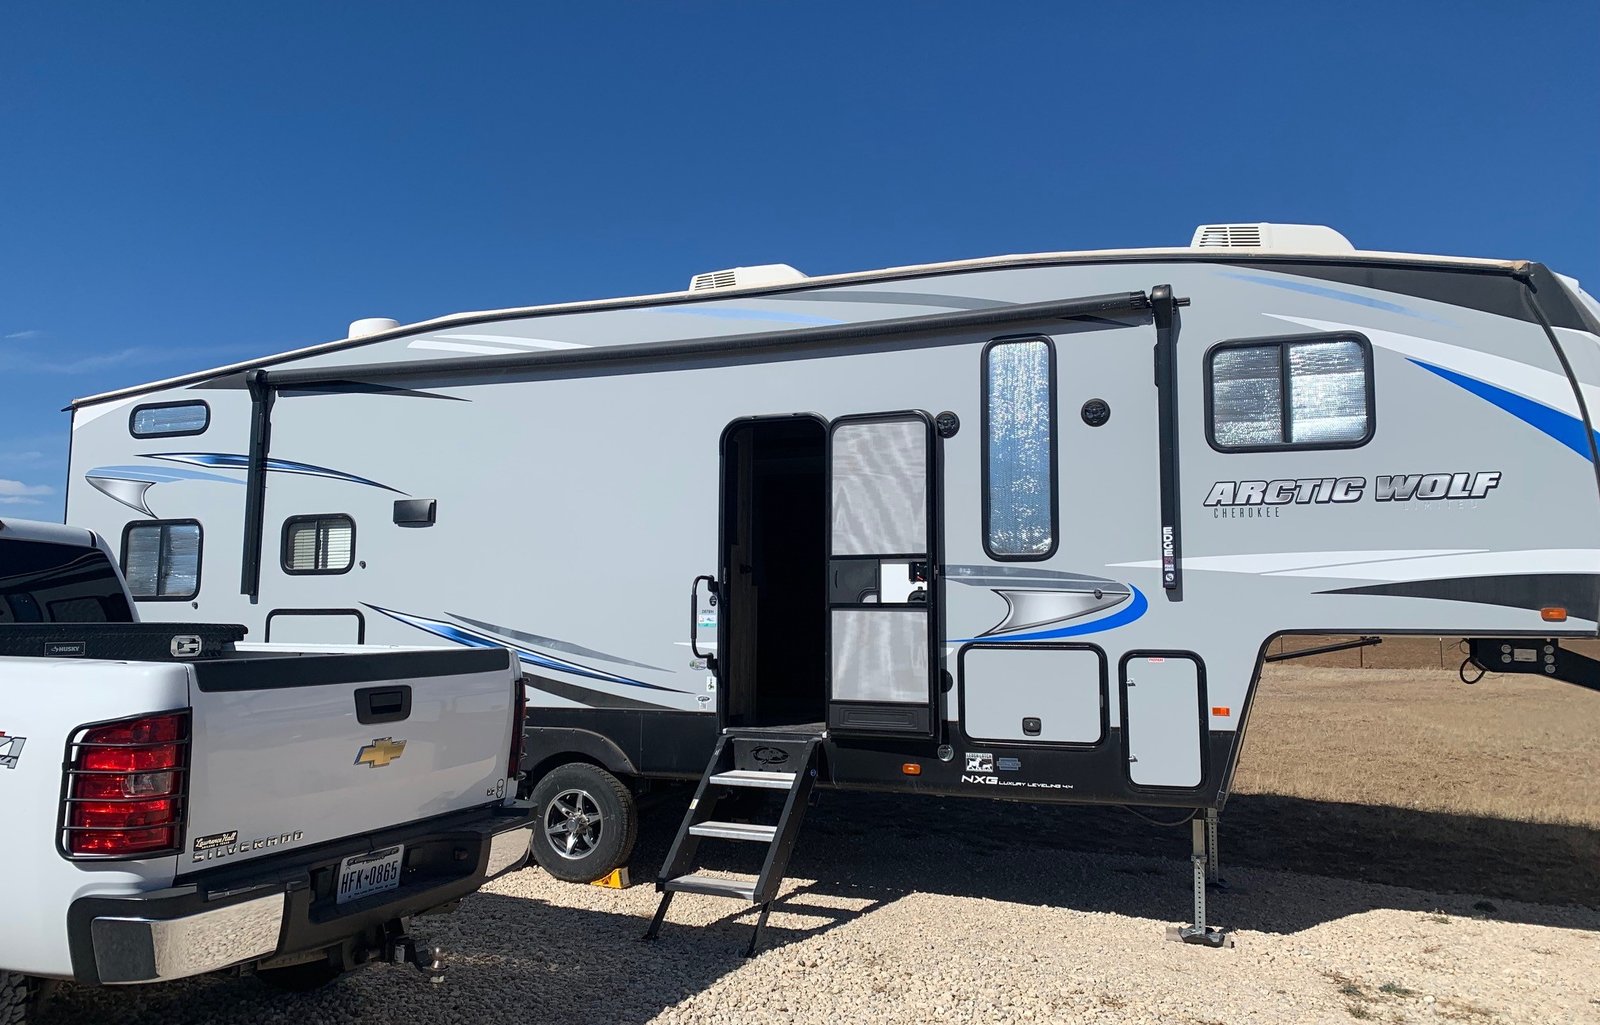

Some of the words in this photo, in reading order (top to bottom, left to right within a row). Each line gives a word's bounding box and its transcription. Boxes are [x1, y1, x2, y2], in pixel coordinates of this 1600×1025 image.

[1203, 477, 1366, 507] ARCTIC
[1375, 471, 1502, 502] WOLF
[1213, 507, 1280, 518] CHEROKEE
[1163, 526, 1174, 557] EDGE
[961, 774, 999, 785] NXG
[192, 830, 304, 863] SILVERADO
[222, 831, 237, 843] Hall
